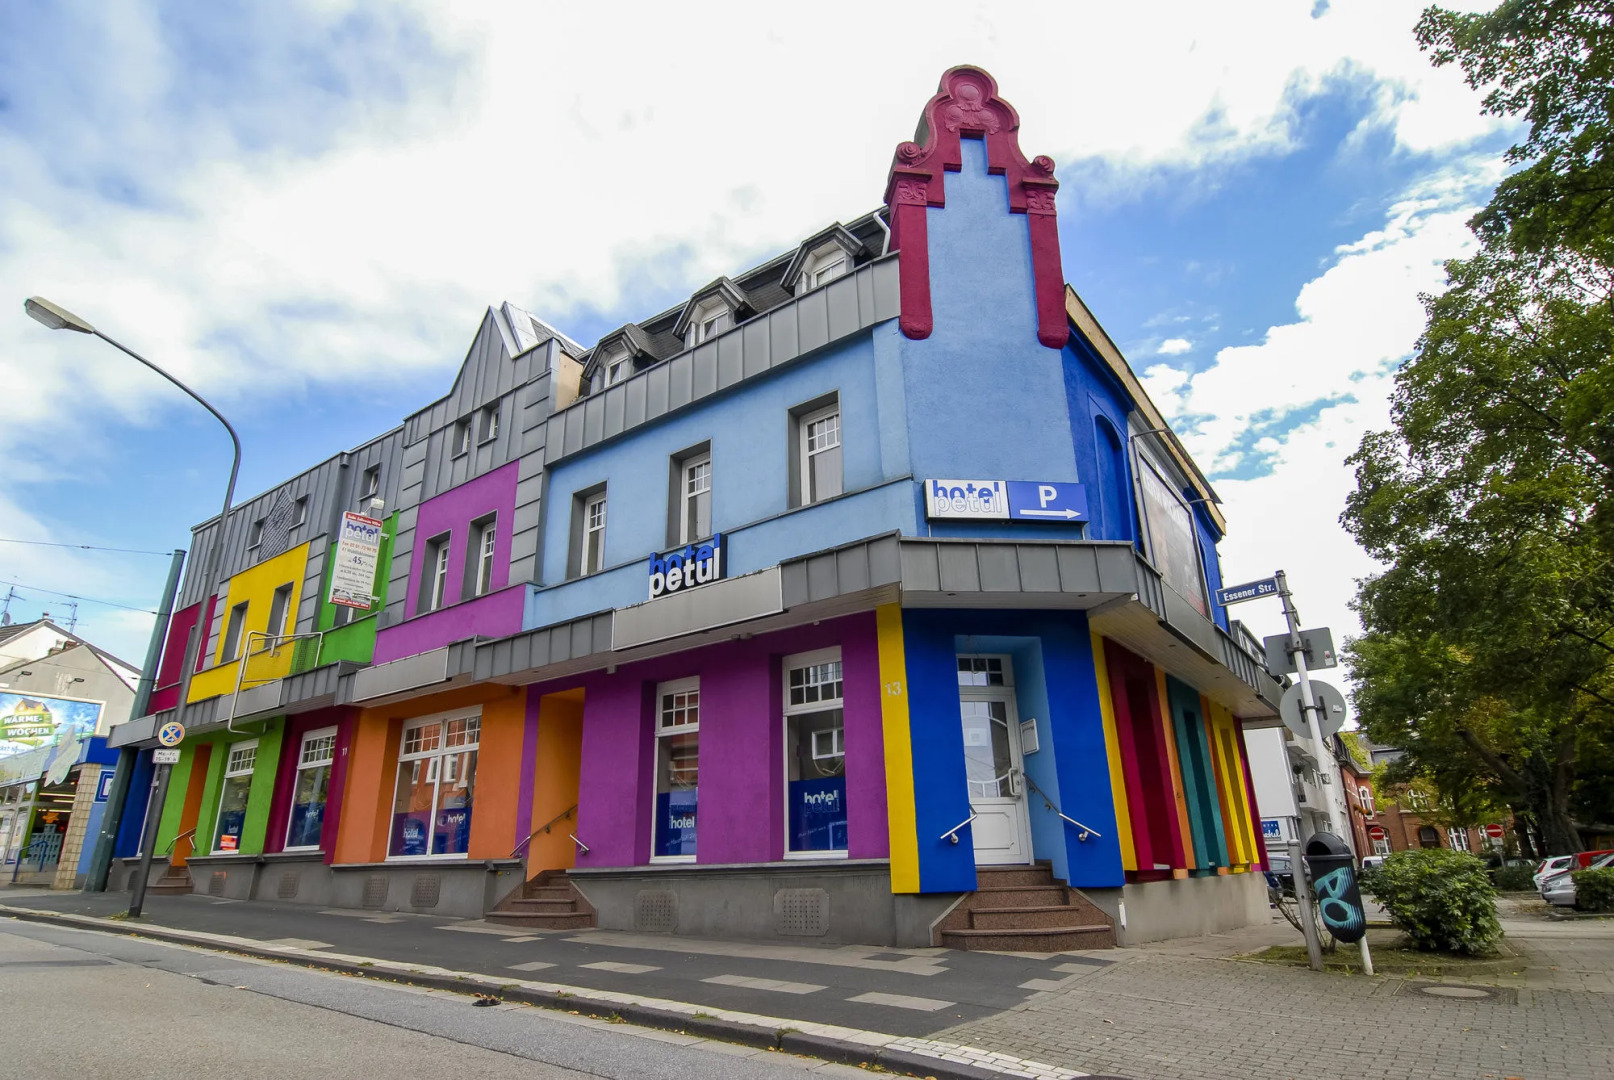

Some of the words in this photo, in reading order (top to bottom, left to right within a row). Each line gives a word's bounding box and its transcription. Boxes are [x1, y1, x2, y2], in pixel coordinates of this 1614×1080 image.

[932, 480, 1000, 503] hotel
[1038, 485, 1058, 508] P
[934, 491, 1003, 516] petul
[649, 532, 721, 576] hotel
[648, 547, 720, 601] petul
[1223, 588, 1256, 602] Essener
[1258, 584, 1275, 594] Str.
[885, 681, 902, 697] 13
[803, 790, 838, 806] hotel
[670, 815, 696, 829] hotel
